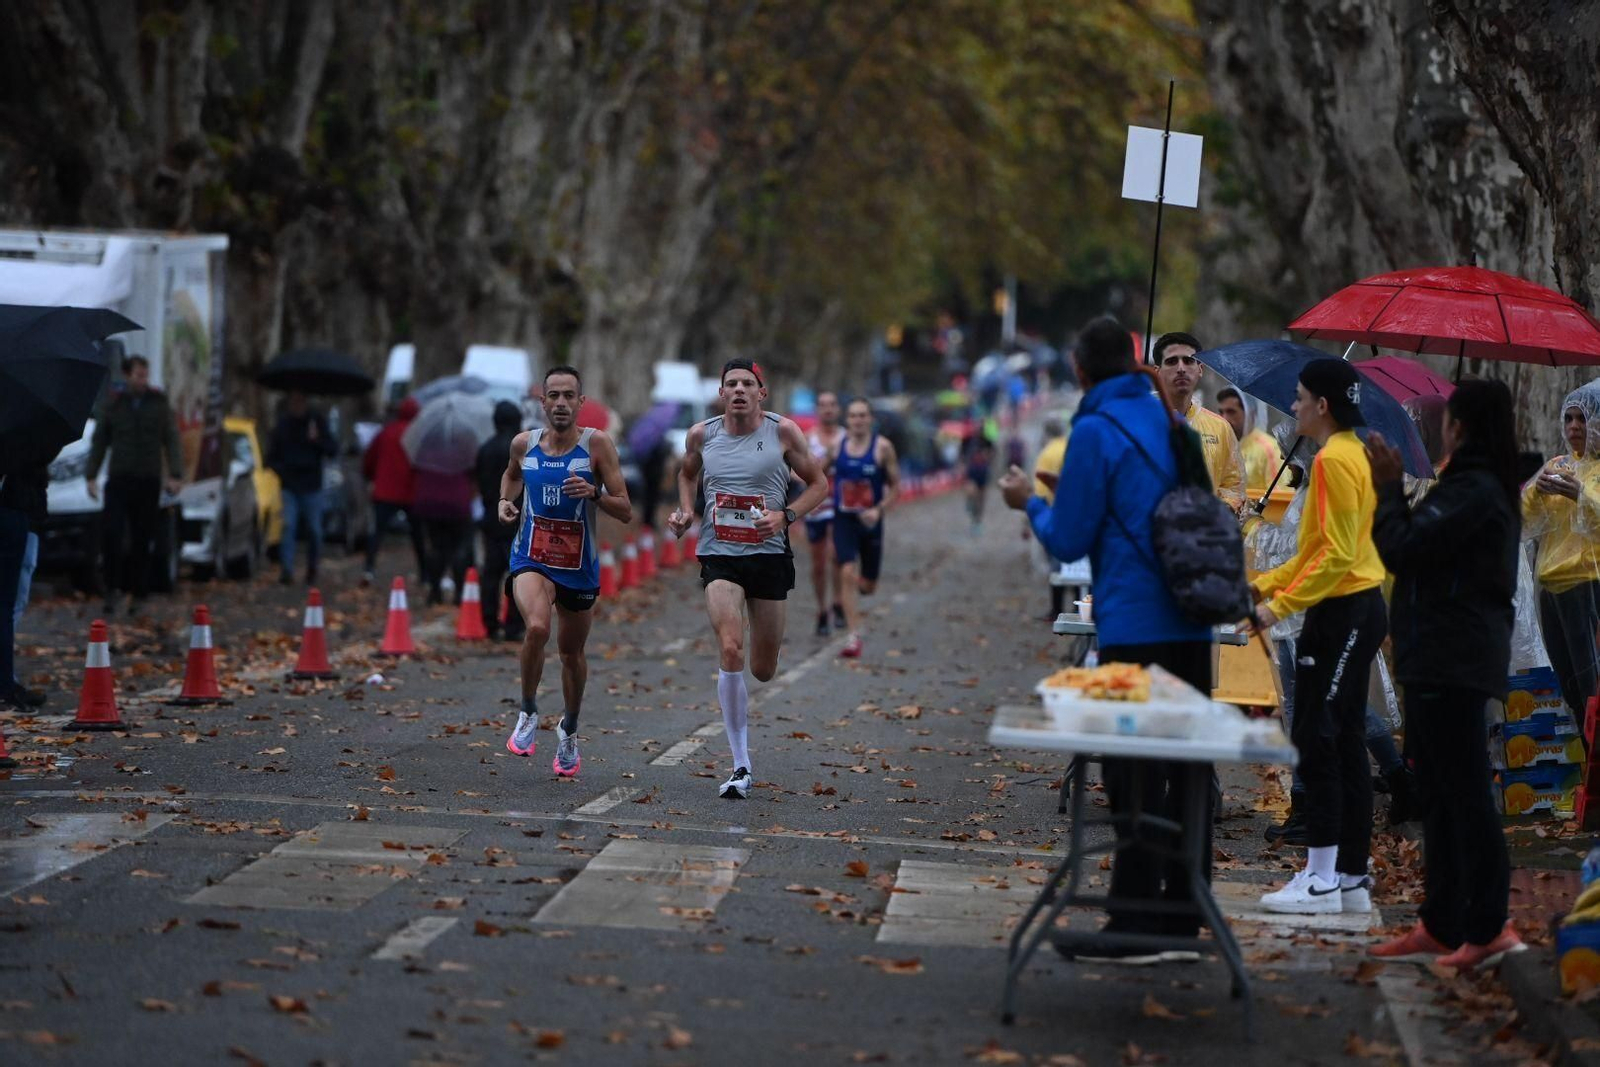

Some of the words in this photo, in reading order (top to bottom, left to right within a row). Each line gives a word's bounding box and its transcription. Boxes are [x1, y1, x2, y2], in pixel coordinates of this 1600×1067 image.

[542, 460, 565, 468] Joma
[734, 512, 745, 520] 26
[1325, 683, 1338, 701] THE
[1332, 651, 1350, 683] NORTH
[1345, 628, 1359, 651] FACE
